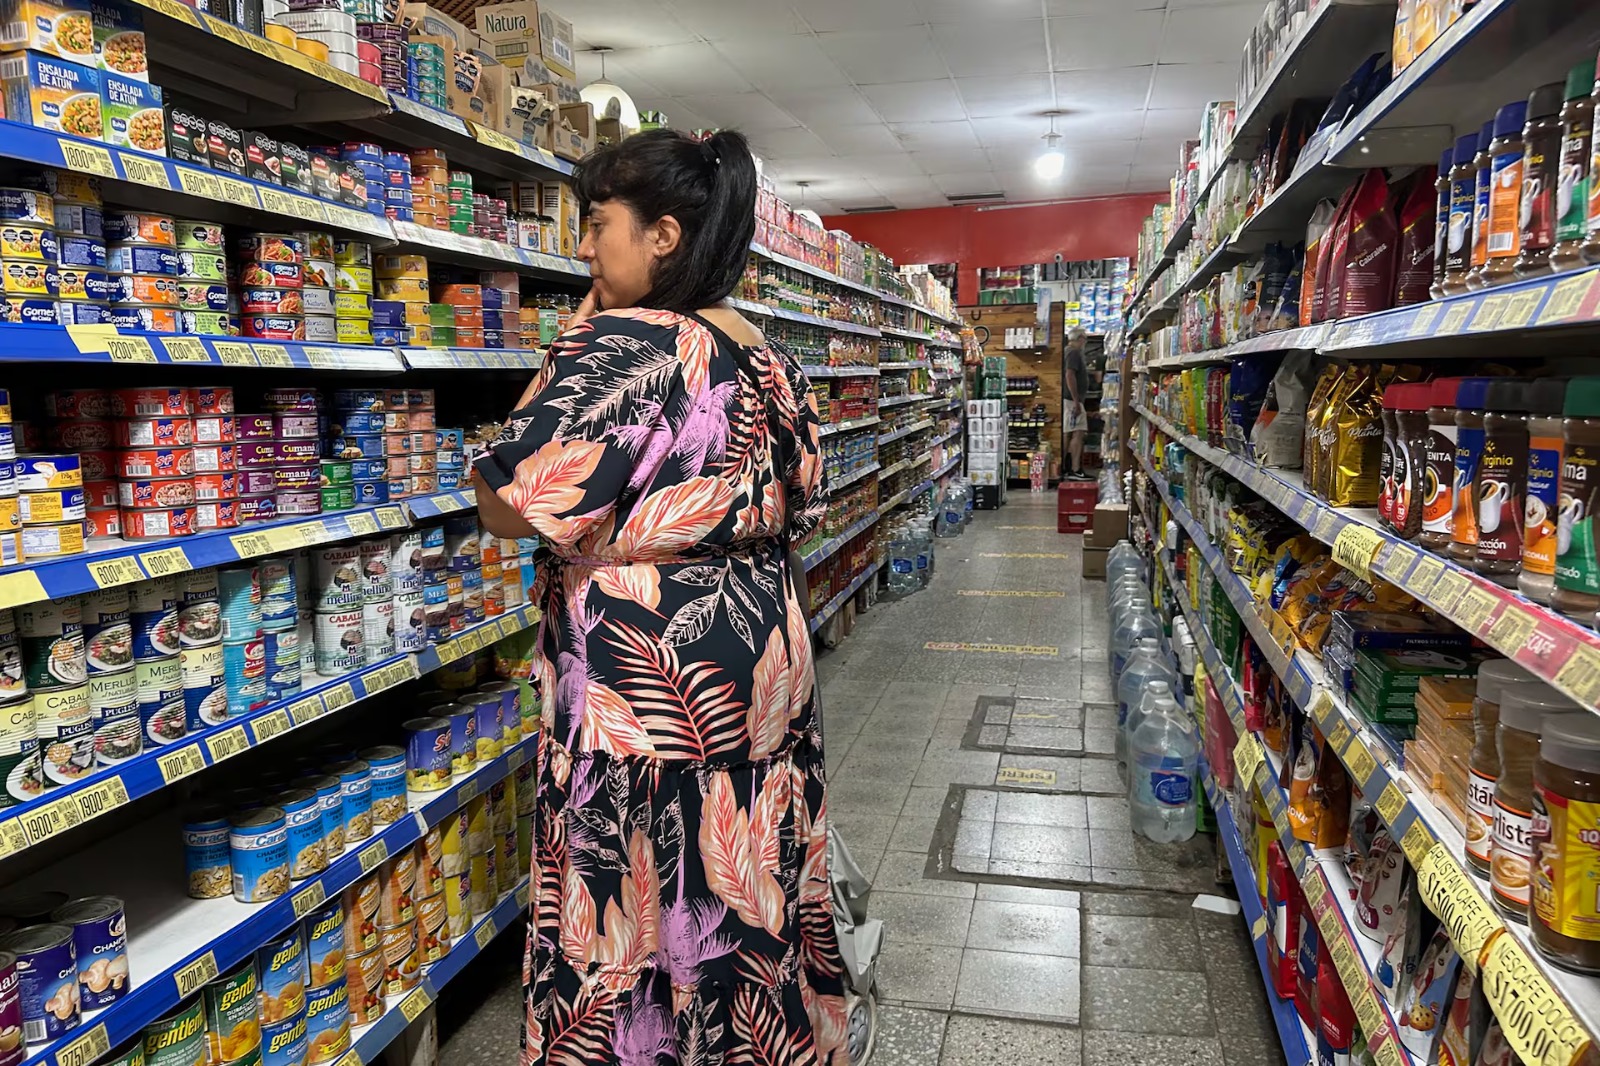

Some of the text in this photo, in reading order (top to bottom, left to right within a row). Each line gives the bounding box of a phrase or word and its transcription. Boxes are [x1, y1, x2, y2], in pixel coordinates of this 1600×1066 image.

[92, 4, 121, 21] SALADA
[485, 14, 526, 34] Natura
[38, 61, 79, 82] ENSALADA
[108, 79, 144, 98] ENSALADA
[23, 307, 54, 317] Gomes
[111, 314, 139, 324] Gomes
[282, 444, 316, 454] Cumaná
[1427, 451, 1453, 463] ENITA
[275, 468, 311, 479] Cumaná
[25, 813, 53, 843] 1900
